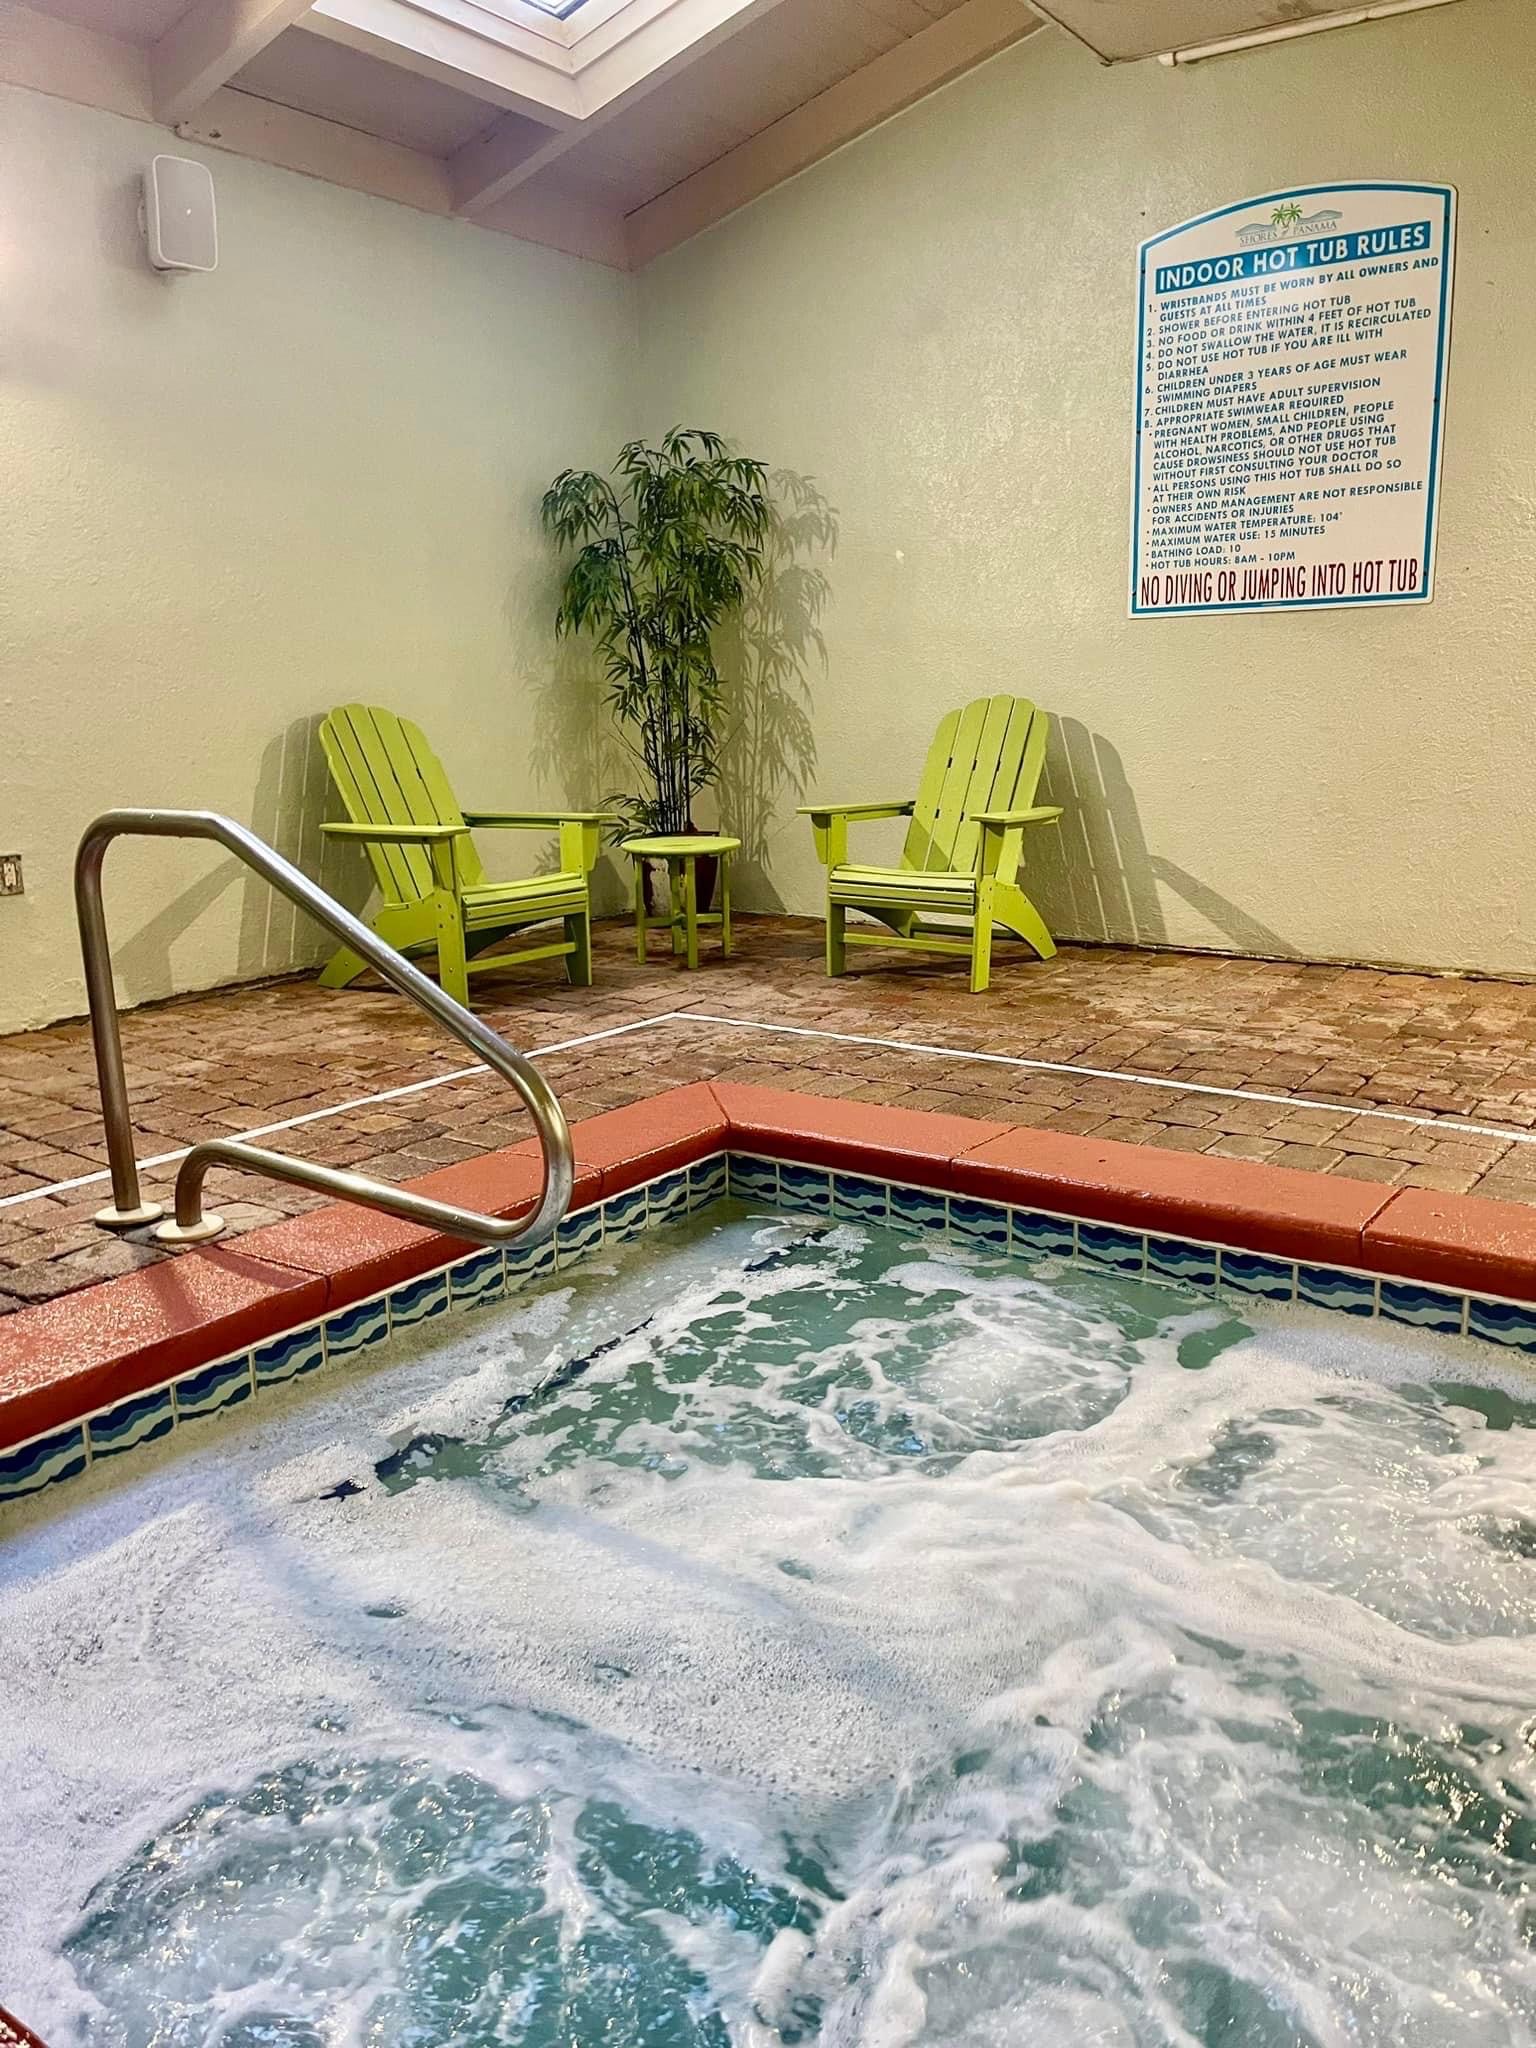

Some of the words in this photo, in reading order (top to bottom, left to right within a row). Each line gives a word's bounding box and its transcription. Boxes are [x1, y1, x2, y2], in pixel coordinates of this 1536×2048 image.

[1293, 220, 1337, 235] PANAMA
[1160, 256, 1244, 289] INDOOR
[1253, 246, 1298, 274] HOT
[1306, 237, 1348, 264] TUB
[1357, 224, 1424, 256] RULES
[1160, 290, 1226, 311] WRISTBANDS
[1230, 284, 1259, 299] MUST
[1263, 282, 1276, 293] BE
[1279, 276, 1314, 291] WORN
[1318, 272, 1333, 284] BY
[1335, 268, 1355, 282] ALL
[1358, 260, 1408, 278] OWNERS
[1412, 255, 1438, 270] AND
[1158, 318, 1199, 334] SHOWER
[1204, 311, 1242, 327] BEFORE
[1246, 302, 1299, 320] ENTERING
[1303, 297, 1326, 311] HOT
[1329, 294, 1350, 307] TUB
[1158, 335, 1174, 346] NO
[1177, 329, 1206, 343] FOOD
[1210, 326, 1224, 338] OR
[1229, 321, 1262, 335] DRINK
[1266, 314, 1304, 329] WITHIN
[1308, 312, 1314, 323] 4
[1318, 307, 1343, 321] FEET
[1346, 305, 1362, 317] OF
[1366, 300, 1390, 314] HOT
[1394, 297, 1416, 310] TUB
[1159, 307, 1196, 322] GUESTS
[1199, 304, 1211, 315] AT
[1214, 301, 1231, 313] ALL
[1235, 295, 1266, 309] TIMES
[1157, 358, 1172, 370] DO
[1176, 355, 1197, 367] NOT
[1200, 351, 1219, 364] USE
[1222, 347, 1244, 360] HOT
[1247, 344, 1267, 356] TUB
[1271, 342, 1280, 353] IF
[1283, 338, 1307, 351] YOU
[1310, 334, 1333, 347] ARE
[1336, 332, 1350, 343] ILL
[1354, 327, 1382, 341] WITH
[1158, 347, 1173, 358] DO
[1176, 343, 1198, 355] NOT
[1201, 334, 1251, 351] SWALLOW
[1254, 330, 1274, 343] THE
[1277, 324, 1317, 341] WATER,
[1321, 322, 1330, 333] IT
[1334, 320, 1343, 331] IS
[1347, 307, 1431, 329] RECIRCULATED
[1157, 376, 1205, 392] CHILDREN
[1209, 371, 1243, 385] UNDER
[1247, 369, 1253, 380] 3
[1257, 364, 1291, 379] YEARS
[1295, 361, 1310, 373] OF
[1313, 358, 1336, 371] AGE
[1339, 353, 1370, 367] MUST
[1374, 348, 1407, 363] WEAR
[1157, 364, 1208, 381] DIARRHEA
[1154, 400, 1203, 415] CHILDREN
[1206, 395, 1234, 409] MUST
[1237, 391, 1265, 405] HAVE
[1269, 386, 1303, 400] ADULT
[1307, 376, 1380, 396] SUPERVISION
[1157, 387, 1210, 403] SWIMMING
[1213, 381, 1257, 396] DIAPERS
[1154, 423, 1207, 439] PREGNANT
[1210, 417, 1252, 432] WOMEN,
[1256, 412, 1290, 426] SMALL
[1292, 405, 1349, 423] CHILDREN,
[1353, 399, 1394, 414] PEOPLE
[1156, 409, 1224, 427] APPROPRIATE
[1227, 401, 1284, 418] SWIMWEAR
[1289, 393, 1344, 410] REQUIRED
[1153, 437, 1177, 449] WITH
[1180, 433, 1217, 446] HEALTH
[1220, 425, 1275, 441] PROBLEMS,
[1279, 422, 1303, 435] AND
[1306, 417, 1346, 431] PEOPLE
[1350, 413, 1384, 426] USING
[1153, 445, 1202, 460] ALCOHOL,
[1205, 438, 1265, 455] NARCOTICS,
[1269, 436, 1284, 447] OR
[1287, 431, 1322, 445] OTHER
[1326, 426, 1364, 440] DRUGS
[1367, 423, 1396, 436] THAT
[1152, 468, 1196, 481] WITHOUT
[1199, 464, 1225, 477] FIRST
[1228, 457, 1294, 474] CONSULTING
[1298, 453, 1327, 466] YOUR
[1331, 448, 1378, 463] DOCTOR
[1153, 458, 1183, 470] CAUSE
[1186, 451, 1249, 467] DROWSINESS
[1253, 446, 1294, 460] SHOULD
[1298, 443, 1321, 455] NOT
[1324, 440, 1344, 452] USE
[1348, 437, 1371, 450] HOT
[1375, 435, 1396, 447] TUB
[1152, 482, 1168, 492] ALL
[1172, 477, 1216, 491] PERSONS
[1219, 474, 1250, 486] USING
[1254, 471, 1276, 483] THIS
[1279, 468, 1301, 480] HOT
[1304, 466, 1325, 478] TUB
[1328, 462, 1361, 475] SHALL
[1365, 460, 1382, 471] DO
[1386, 458, 1401, 469] SO
[1152, 493, 1164, 503] AT
[1167, 490, 1193, 502] THEIR
[1196, 488, 1220, 499] OWN
[1224, 485, 1246, 496] RISK
[1152, 501, 1192, 514] OWNERS
[1195, 499, 1217, 511] AND
[1220, 492, 1296, 509] MANAGEMENT
[1298, 490, 1319, 501] ARE
[1322, 487, 1346, 499] NOT
[1349, 479, 1422, 496] RESPONSIBLE
[1151, 523, 1201, 537] MAXIMUM
[1204, 520, 1236, 532] WATER
[1239, 513, 1315, 529] TEMPERATURE:
[1152, 515, 1170, 525] FOR
[1174, 509, 1227, 523] ACCIDENTS
[1230, 508, 1245, 518] OR
[1249, 503, 1294, 517] INJURIES
[1151, 535, 1200, 547] MAXIMUM
[1203, 532, 1235, 543] WATER
[1239, 530, 1260, 541] USE:
[1264, 529, 1275, 539] 15
[1279, 524, 1325, 538] MINUTES
[1151, 547, 1192, 559] BATHING
[1229, 543, 1240, 553] 10
[1150, 559, 1170, 570] HOT
[1173, 558, 1190, 568] TUB
[1194, 555, 1231, 567] HOURS:
[1234, 553, 1257, 564] 8AM
[1268, 550, 1295, 561] 10PM
[1141, 575, 1159, 606] NO
[1165, 571, 1212, 605] DIVING
[1217, 569, 1236, 602] OR
[1240, 565, 1306, 601] JUMPING
[1311, 562, 1346, 596] INTO
[1351, 559, 1382, 594] HOT
[1388, 557, 1417, 593] TUB
